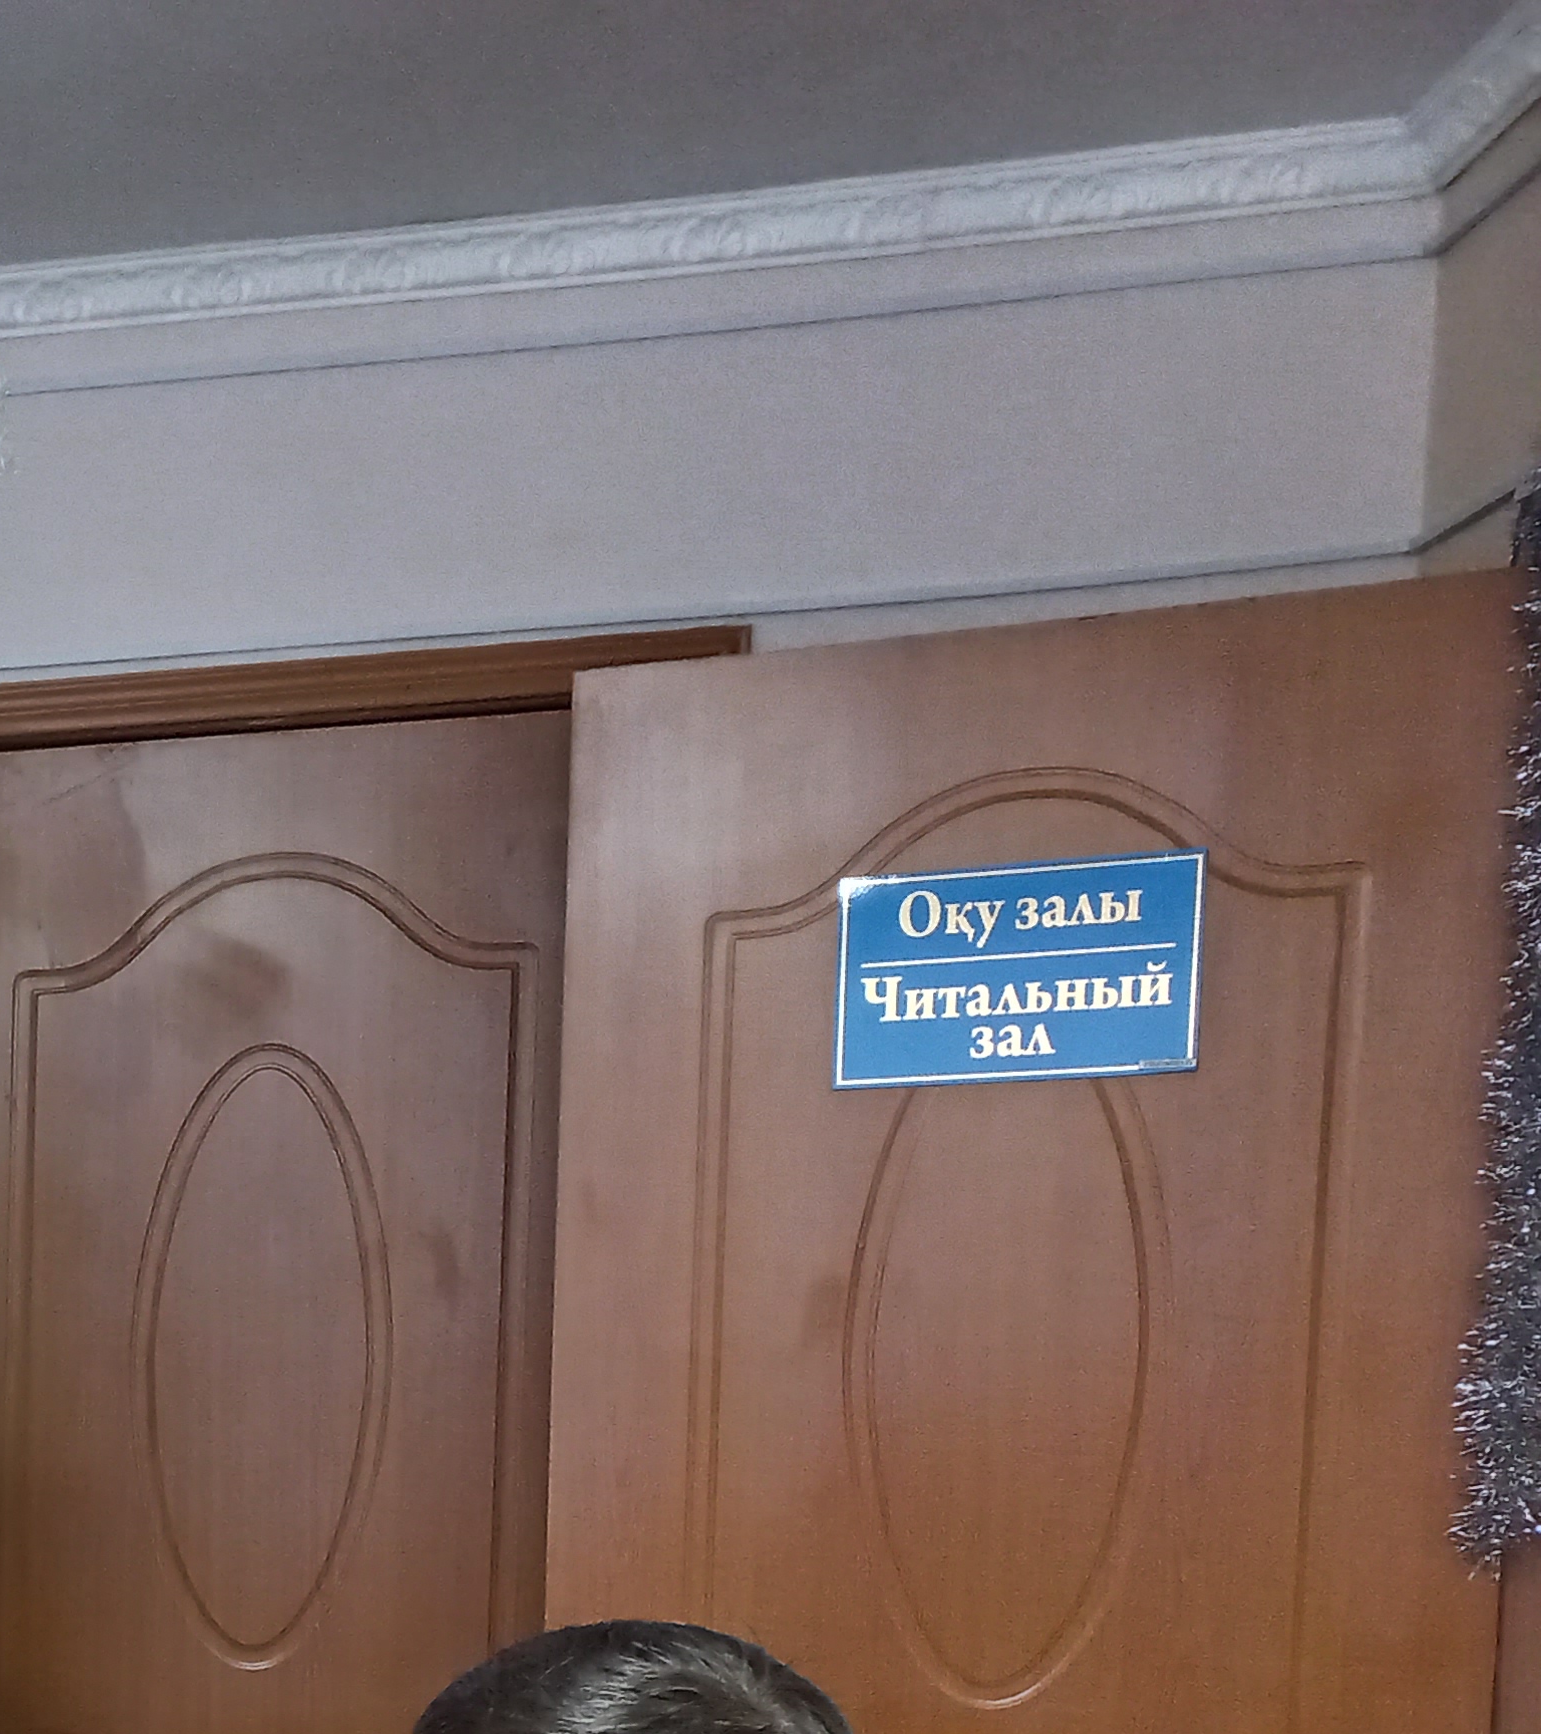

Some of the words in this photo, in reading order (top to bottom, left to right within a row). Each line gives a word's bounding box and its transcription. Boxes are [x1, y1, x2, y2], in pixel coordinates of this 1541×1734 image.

[898, 889, 1006, 948] Оқу
[1014, 889, 1143, 931] залы
[860, 960, 1174, 1024] Читальный
[969, 1023, 1056, 1060] зал
